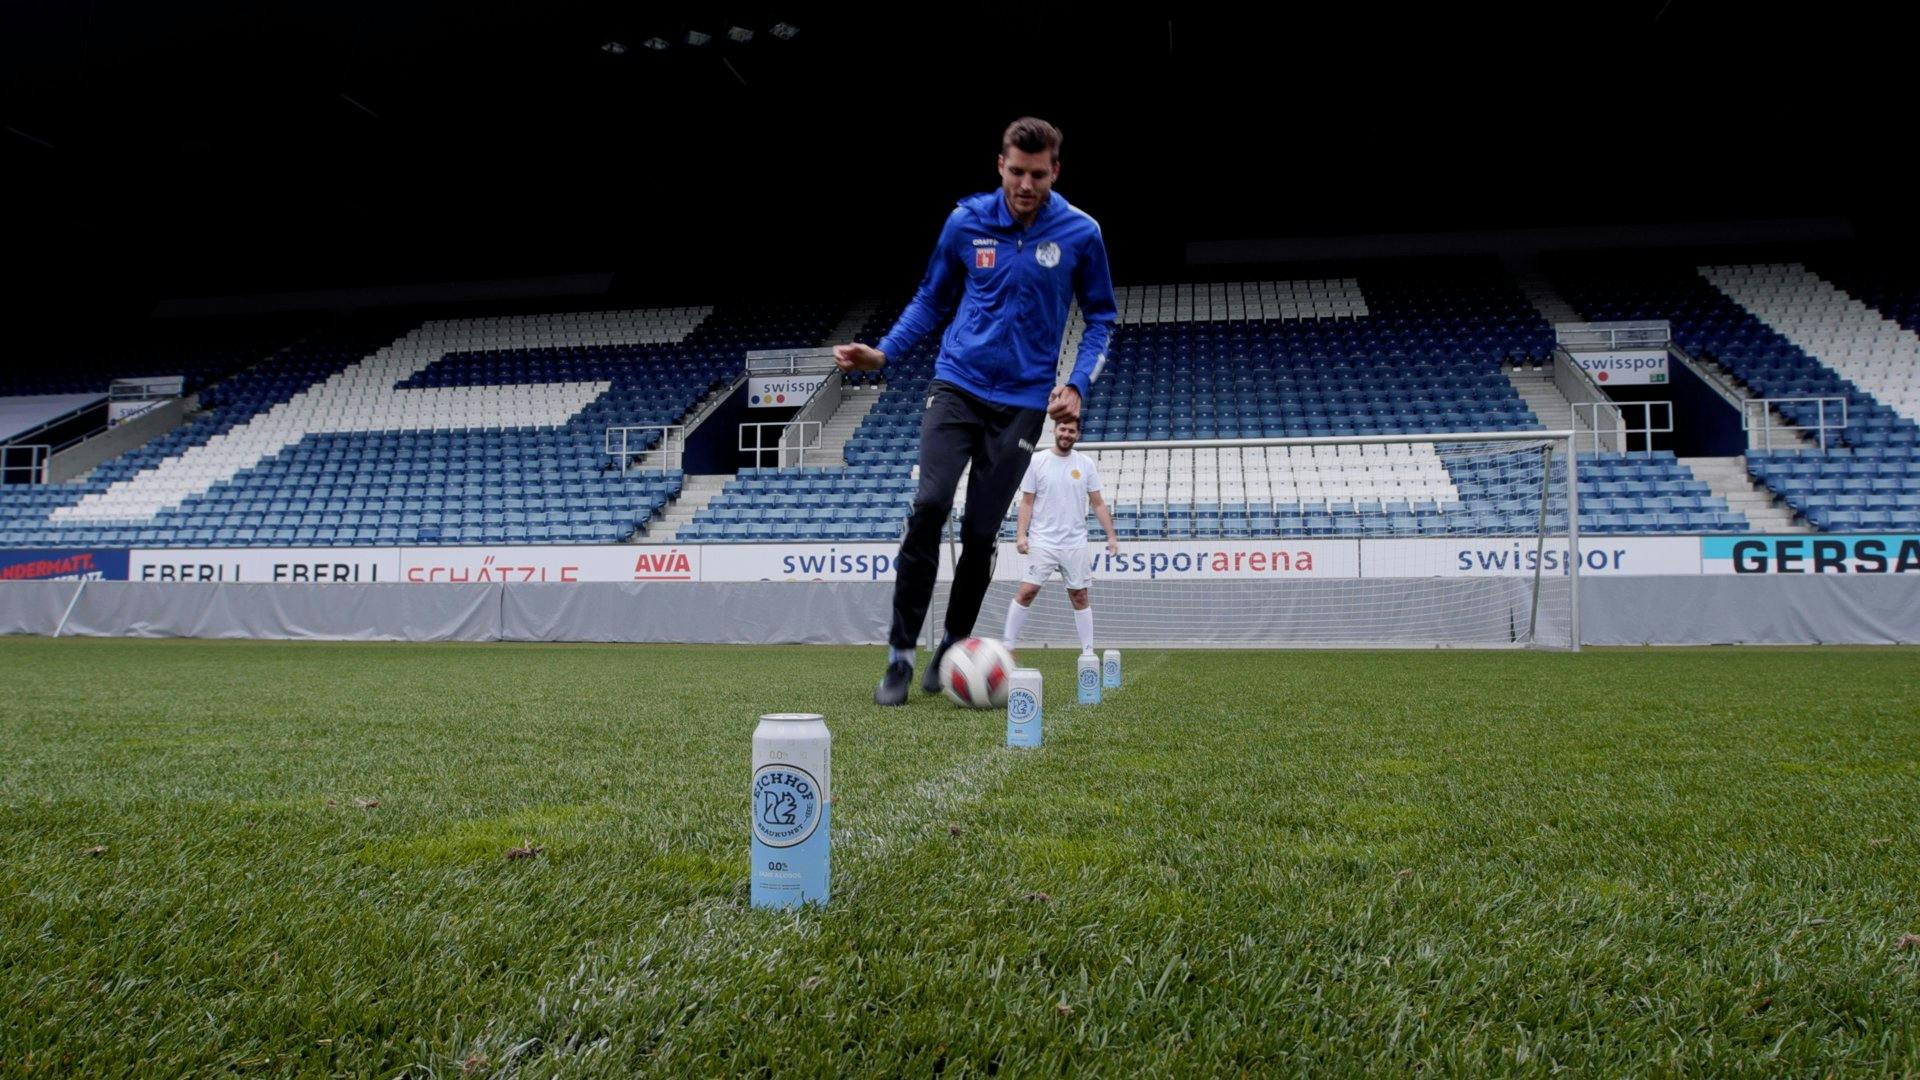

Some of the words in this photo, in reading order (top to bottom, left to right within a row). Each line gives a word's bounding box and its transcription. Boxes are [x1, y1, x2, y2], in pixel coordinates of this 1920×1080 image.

[1582, 355, 1665, 372] swisspor
[0, 553, 96, 579] NDERMATT.
[783, 548, 901, 580] swissp
[1732, 540, 1920, 573] GERSA
[754, 773, 814, 800] EICHHOF
